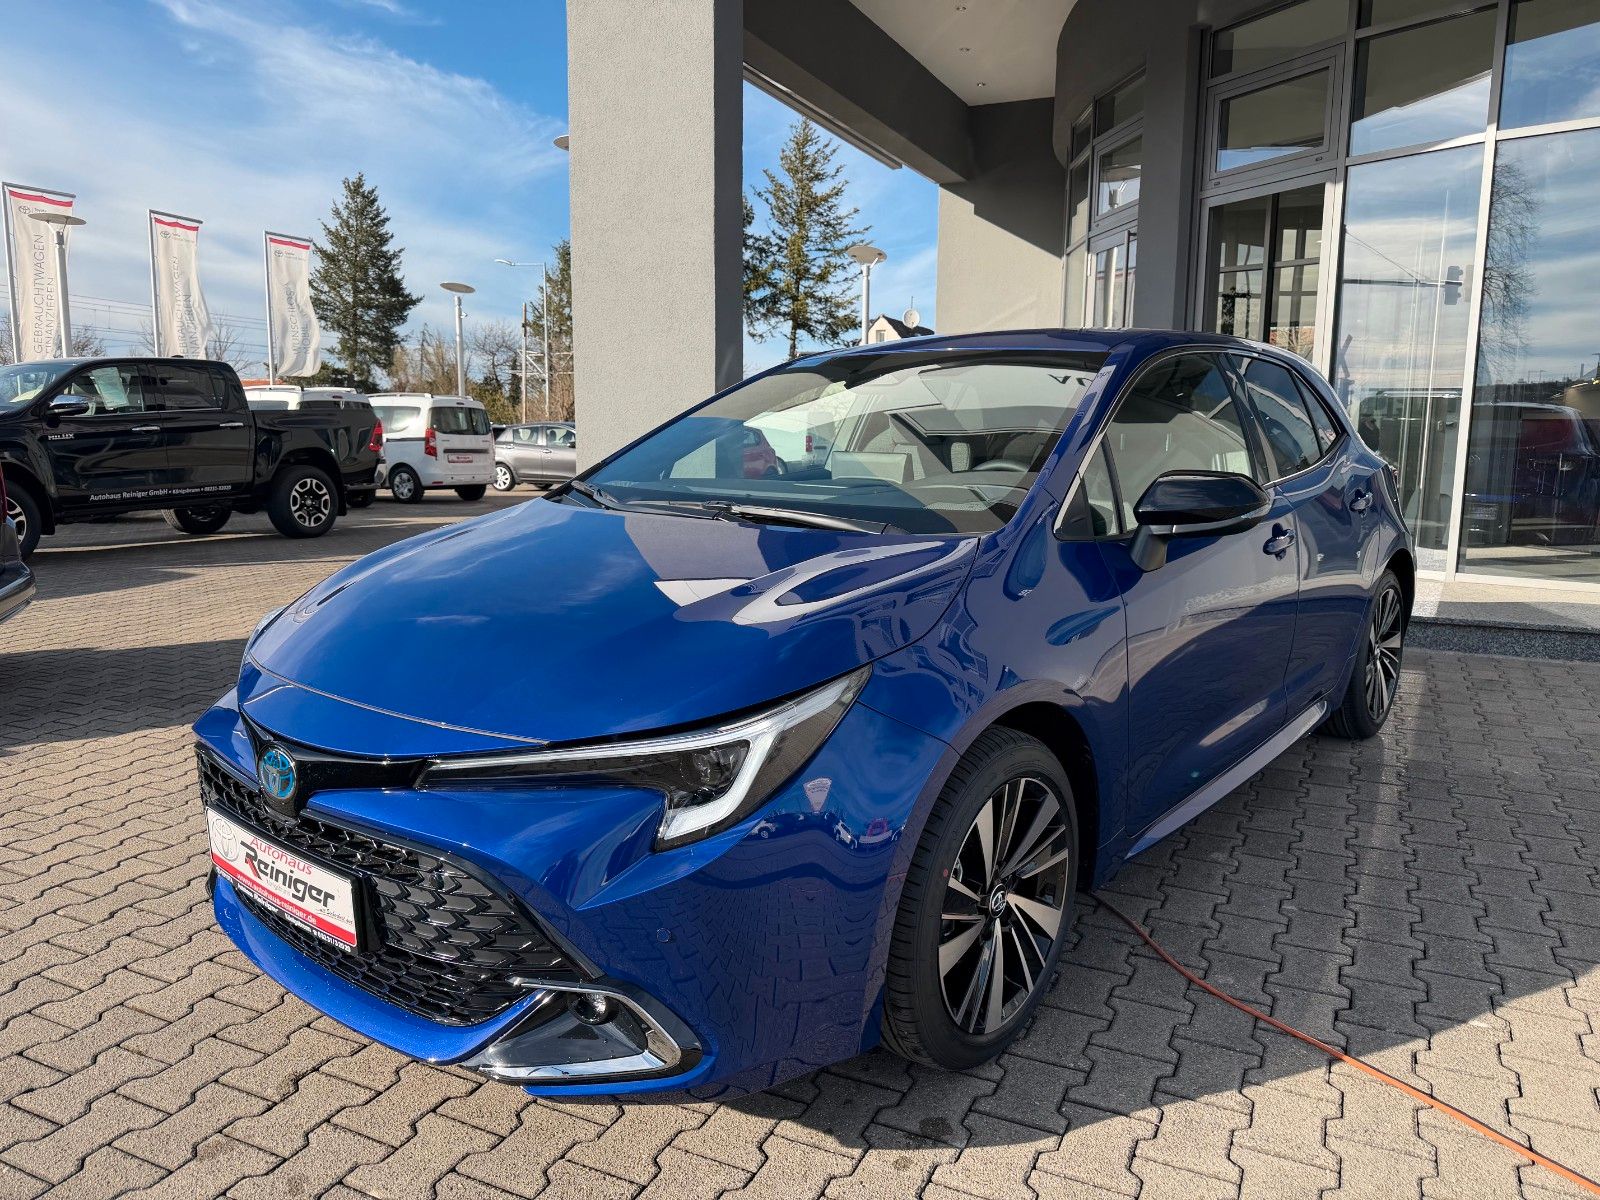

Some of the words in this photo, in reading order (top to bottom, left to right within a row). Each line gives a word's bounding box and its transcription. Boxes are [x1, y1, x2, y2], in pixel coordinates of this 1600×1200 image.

[33, 234, 45, 354] GEBRAUCHTWAGEN
[90, 493, 121, 501] Autohaus
[122, 490, 148, 499] Reiniger
[149, 488, 168, 496] GmbH
[240, 840, 335, 907] Reiniger
[249, 837, 313, 875] Autohaus
[236, 873, 317, 925] www.autohaus-reiniger.de
